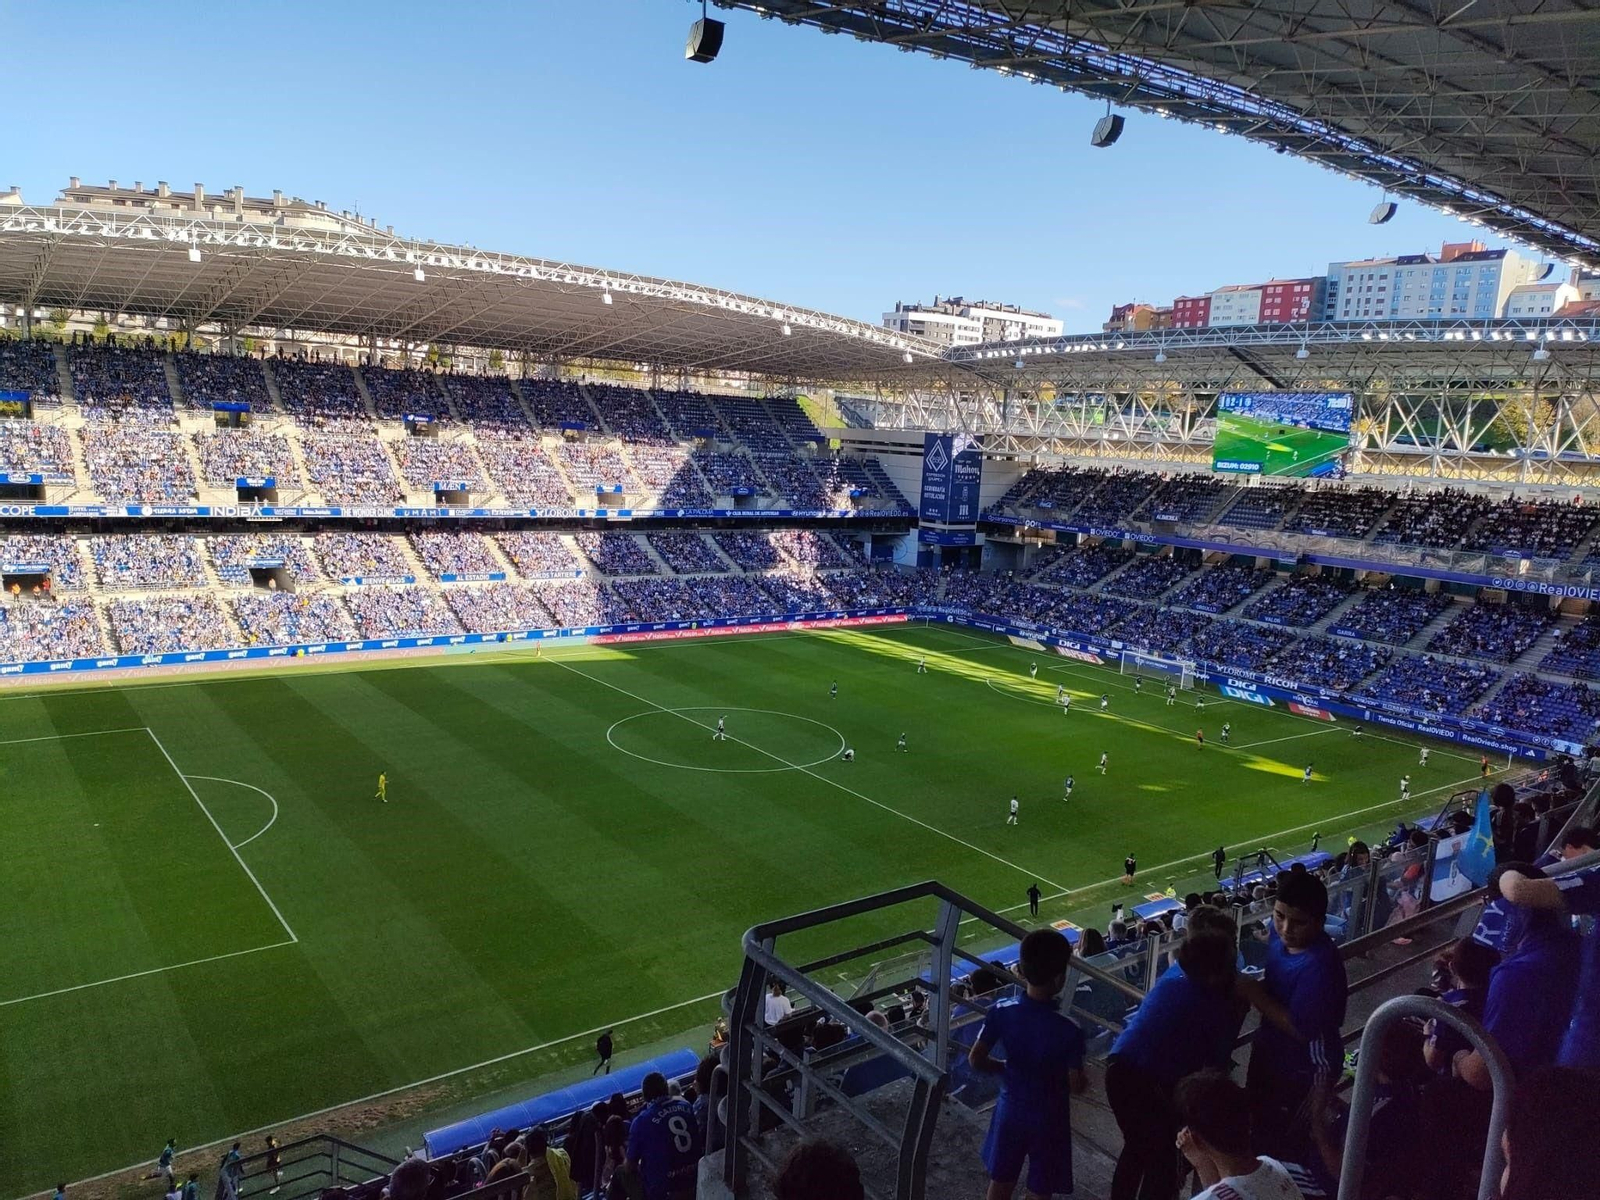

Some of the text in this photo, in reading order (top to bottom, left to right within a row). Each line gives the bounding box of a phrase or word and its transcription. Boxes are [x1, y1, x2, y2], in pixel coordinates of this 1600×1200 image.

[0, 506, 35, 516] COPE
[210, 507, 262, 517] INDIBA
[465, 573, 490, 581] ESTADIO
[1539, 582, 1600, 600] RealOVIE
[1058, 639, 1081, 650] DIGI
[1228, 679, 1257, 691] DIGI
[1264, 675, 1298, 691] RICOH
[1225, 687, 1265, 704] DIGI
[1378, 715, 1455, 738] Tienda Oficial RealOVIEDO
[1462, 733, 1518, 753] RealOviedo.shop
[667, 1115, 692, 1153] 8
